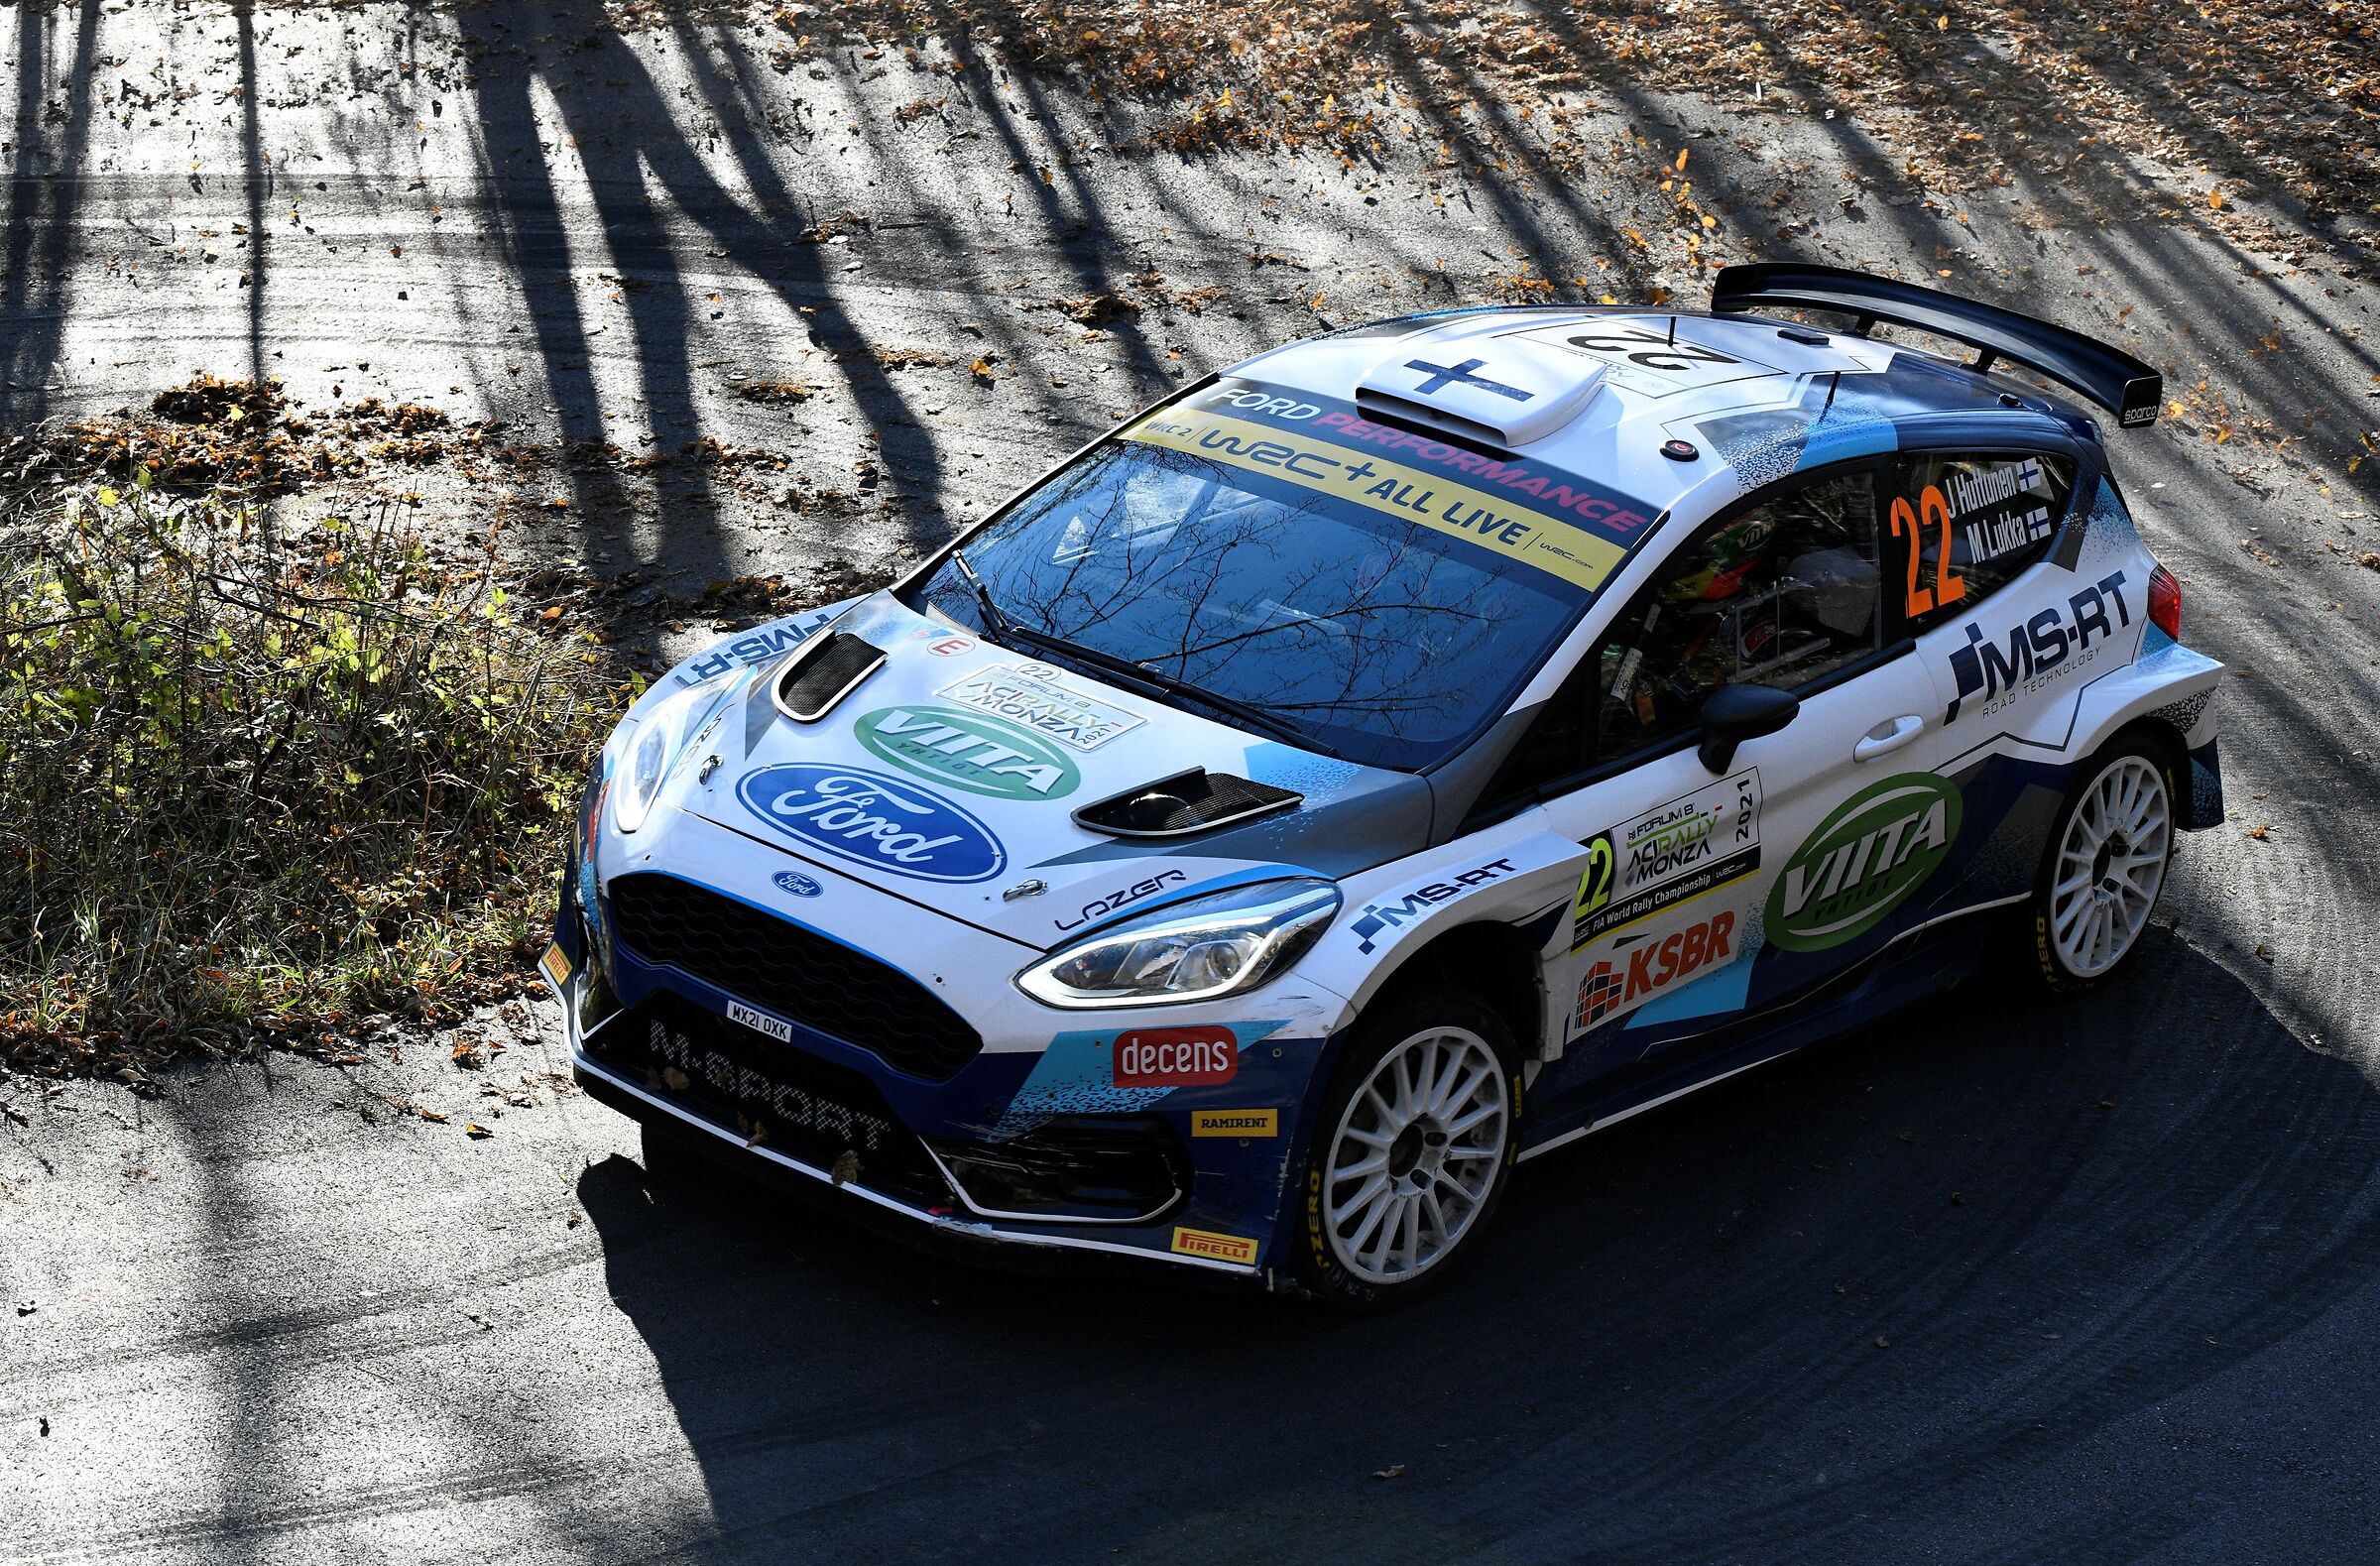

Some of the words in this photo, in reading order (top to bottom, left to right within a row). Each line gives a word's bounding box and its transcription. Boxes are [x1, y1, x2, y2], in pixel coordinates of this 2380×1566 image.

[1567, 329, 1742, 371] 22
[2124, 406, 2157, 424] sparco
[1144, 421, 1178, 433] WRC
[1179, 427, 1193, 436] 2
[1365, 478, 1435, 514] ALL
[1441, 501, 1531, 546] LIVE
[1208, 388, 1322, 421] FORD
[1311, 412, 1648, 533] PERFORMANCE
[1946, 479, 1958, 519] J
[1957, 466, 2017, 515] Huttunen
[1890, 484, 1965, 619] 22
[1965, 522, 1986, 564] M
[1987, 508, 2027, 561] Lukka
[932, 639, 969, 655] E
[1979, 569, 2131, 703] MS-RT
[1007, 675, 1076, 704] FORUM
[1074, 700, 1092, 709] 8
[1019, 665, 1054, 679] 22
[1982, 692, 2016, 720] ROAD
[2022, 645, 2102, 696] TECHNOLOGY
[971, 694, 1080, 741] MONZA
[1077, 727, 1112, 745] 2021
[874, 708, 1064, 794] VIITA
[772, 776, 964, 863] Ford
[1635, 806, 1684, 837] FORUM
[1735, 779, 1753, 843] 2021
[1635, 838, 1712, 885] MONZA
[1782, 797, 1947, 918] VIITA
[776, 873, 816, 896] Ford
[1053, 868, 1187, 931] LAZER
[1375, 857, 1517, 928] MS-RT
[1593, 915, 1605, 932] FIA
[1606, 903, 1630, 926] World
[1632, 897, 1653, 914] Rally
[1654, 875, 1712, 905] Championship
[546, 947, 568, 980] PIRELLI
[1624, 909, 1736, 1005] KSBR
[732, 1005, 760, 1028] MX21
[764, 1018, 787, 1039] OXK
[1122, 1036, 1229, 1075] decens
[650, 1018, 892, 1150] M-SPORT
[1200, 1117, 1268, 1129] RAMIRENT
[1179, 1232, 1250, 1259] PIRELLI
